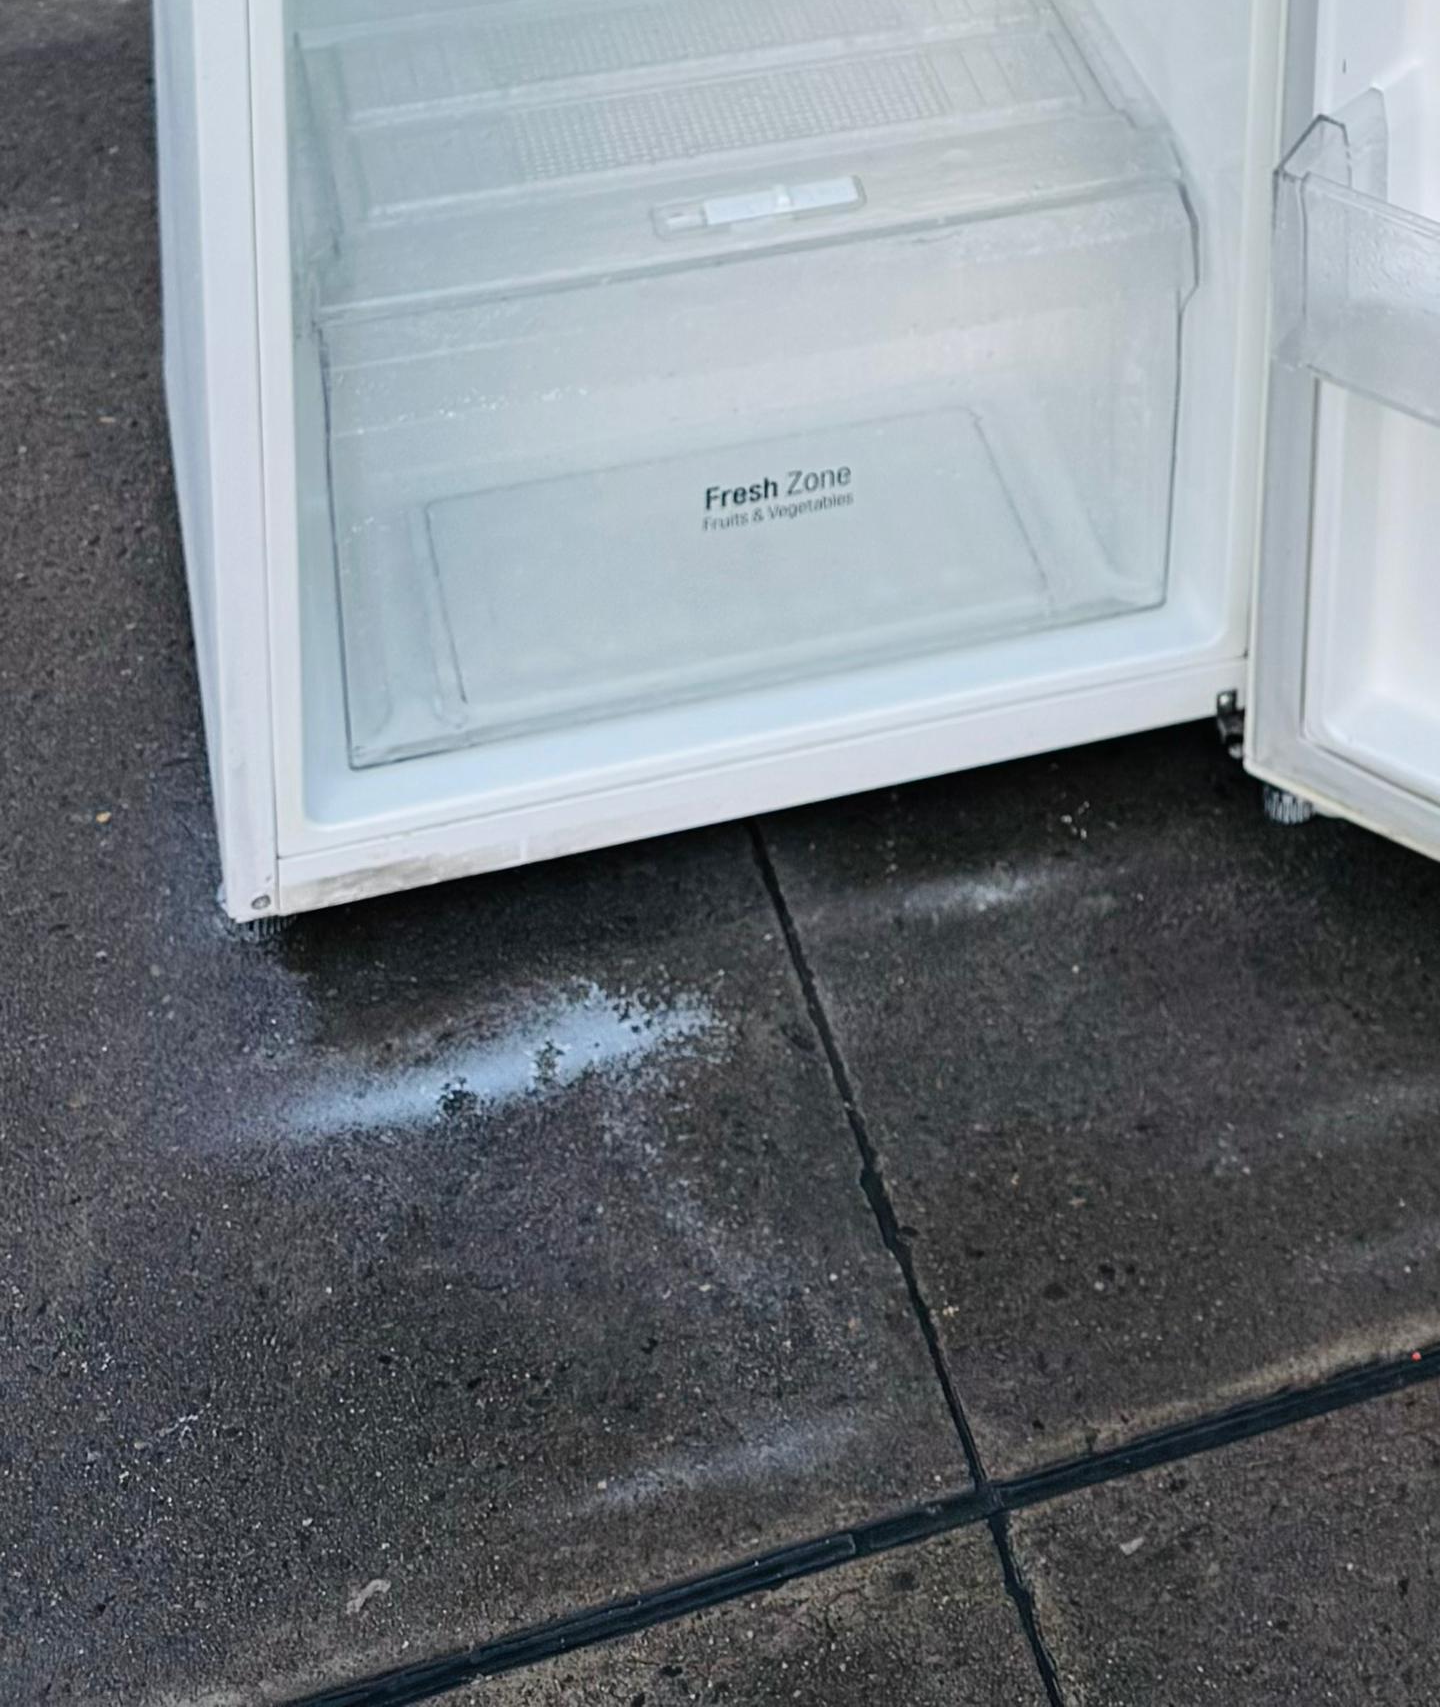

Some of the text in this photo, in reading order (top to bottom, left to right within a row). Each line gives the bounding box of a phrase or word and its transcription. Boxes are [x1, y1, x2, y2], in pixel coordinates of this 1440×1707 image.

[705, 466, 851, 510] Fresh Zone
[702, 492, 854, 532] Fruits & Vegetables
